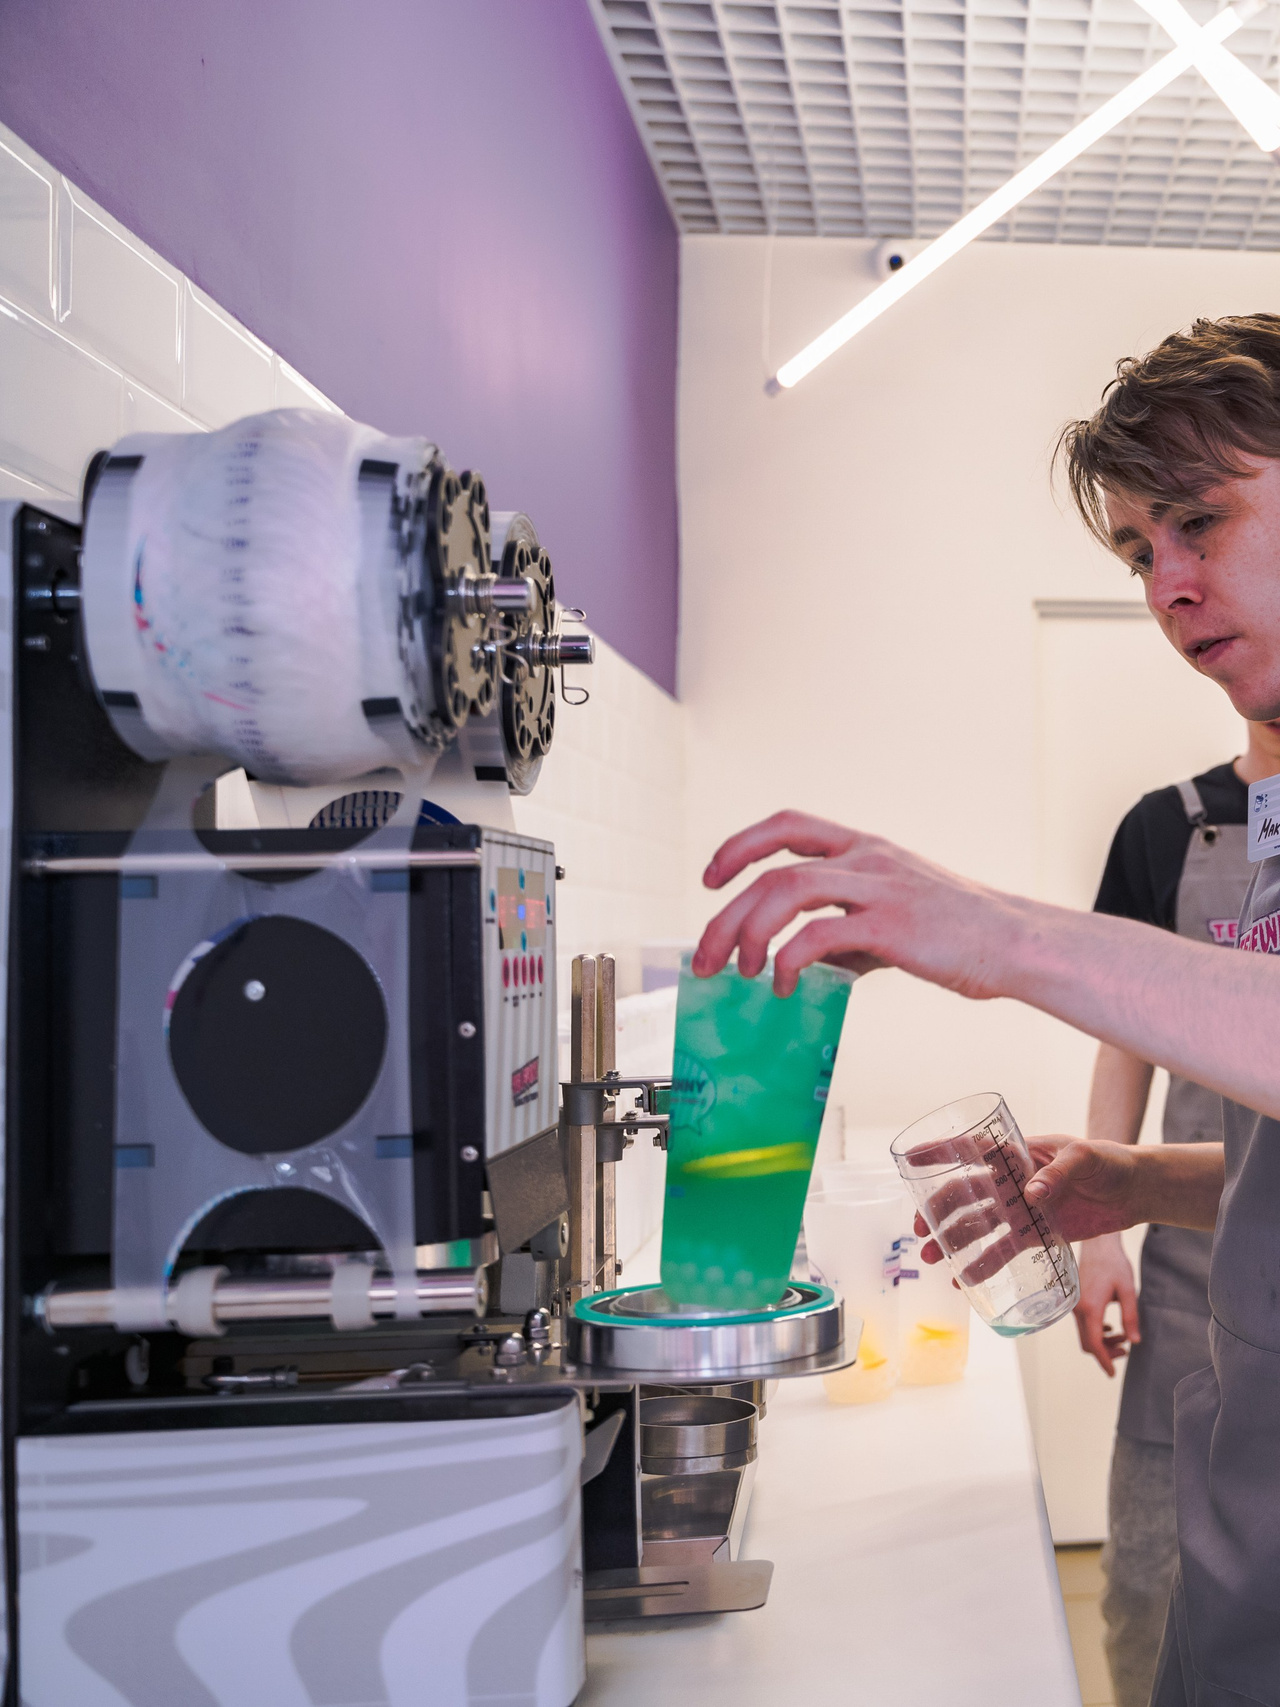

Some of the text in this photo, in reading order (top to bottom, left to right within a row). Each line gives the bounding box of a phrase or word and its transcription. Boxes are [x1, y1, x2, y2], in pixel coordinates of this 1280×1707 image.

[1213, 922, 1238, 938] TE
[992, 1113, 1003, 1126] MAX
[972, 1128, 990, 1143] 700cc
[998, 1129, 1004, 1137] L
[1004, 1138, 1010, 1147] K
[1010, 1150, 1015, 1159] J
[995, 1174, 1008, 1187] 500
[1020, 1172, 1026, 1182] H
[1005, 1197, 1018, 1208] 400
[1038, 1213, 1045, 1221] E
[1018, 1225, 1032, 1237] 300
[1044, 1226, 1051, 1235] D
[1050, 1239, 1057, 1248] C
[1031, 1251, 1044, 1264] 200
[1056, 1253, 1063, 1261] B
[1063, 1268, 1069, 1277] A
[1043, 1280, 1056, 1292] 100
